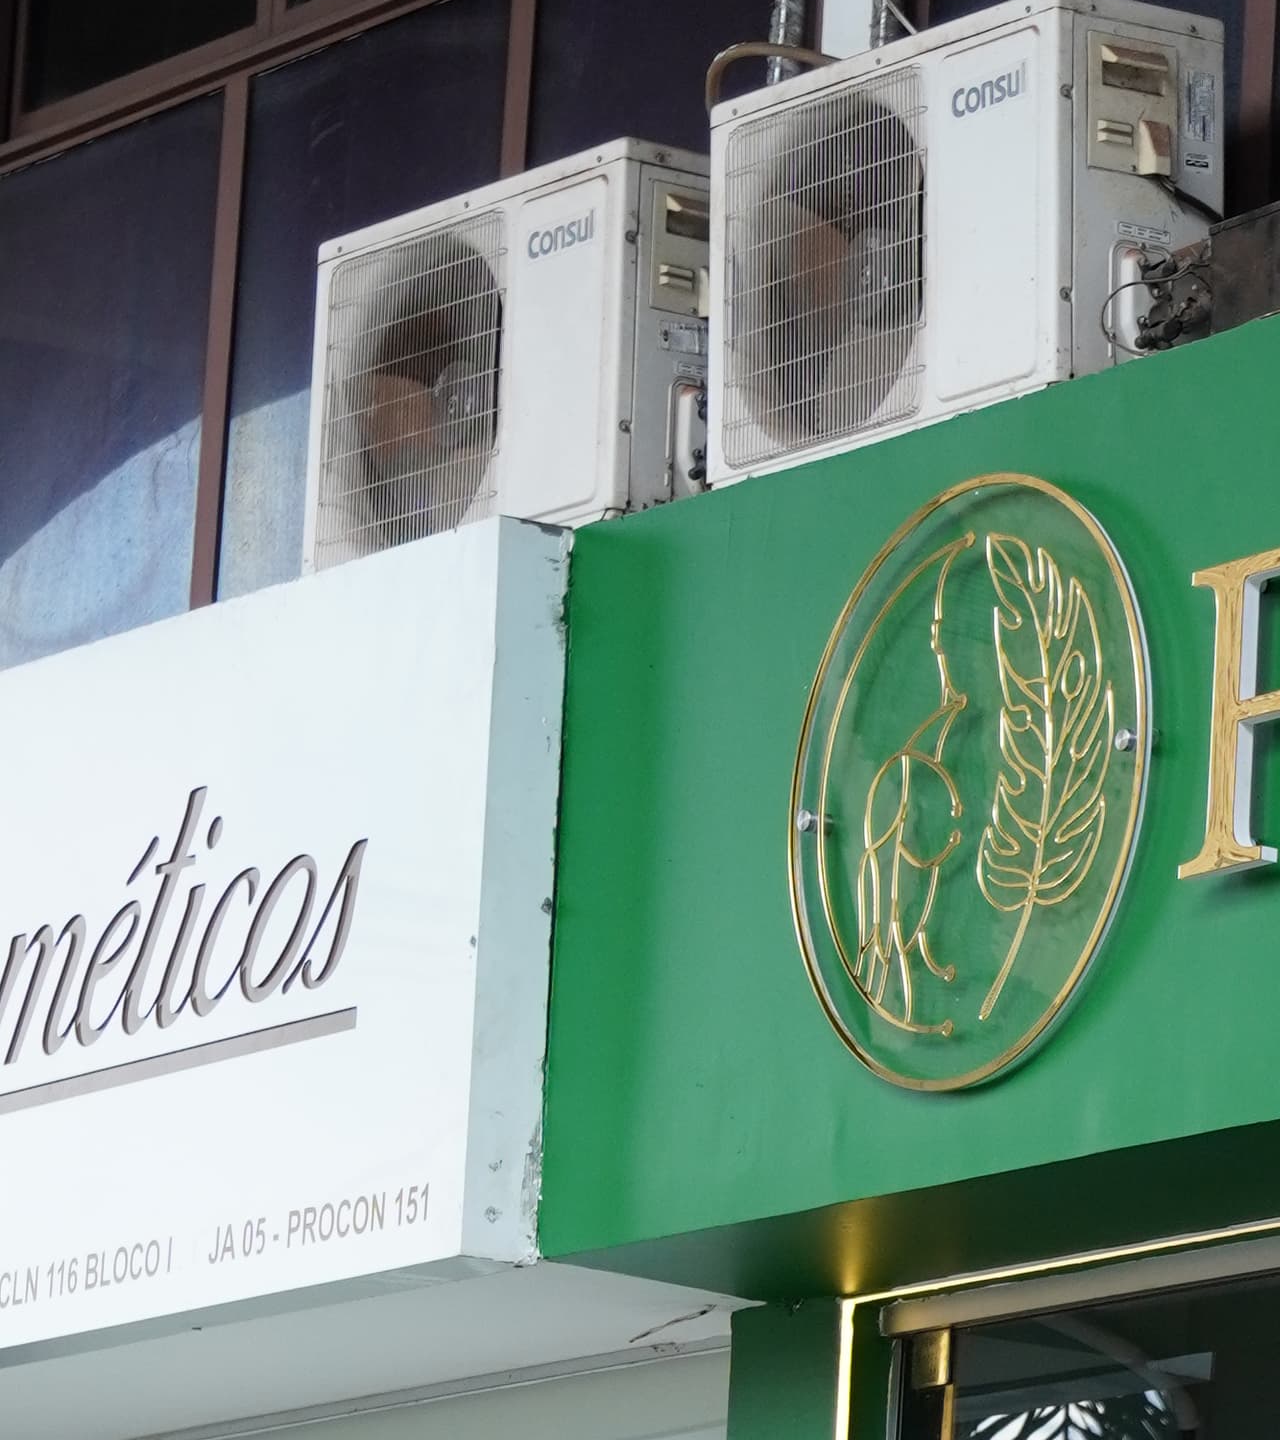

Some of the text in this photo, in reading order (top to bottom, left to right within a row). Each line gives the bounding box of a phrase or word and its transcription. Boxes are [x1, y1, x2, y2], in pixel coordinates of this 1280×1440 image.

[0, 785, 368, 1065] méticos
[0, 1265, 39, 1308] CLN
[47, 1257, 78, 1299] 116
[85, 1239, 160, 1290] BLOCO
[208, 1223, 236, 1264] JA
[242, 1217, 266, 1257] 05
[286, 1191, 386, 1249] PROCON
[395, 1182, 430, 1227] 151
